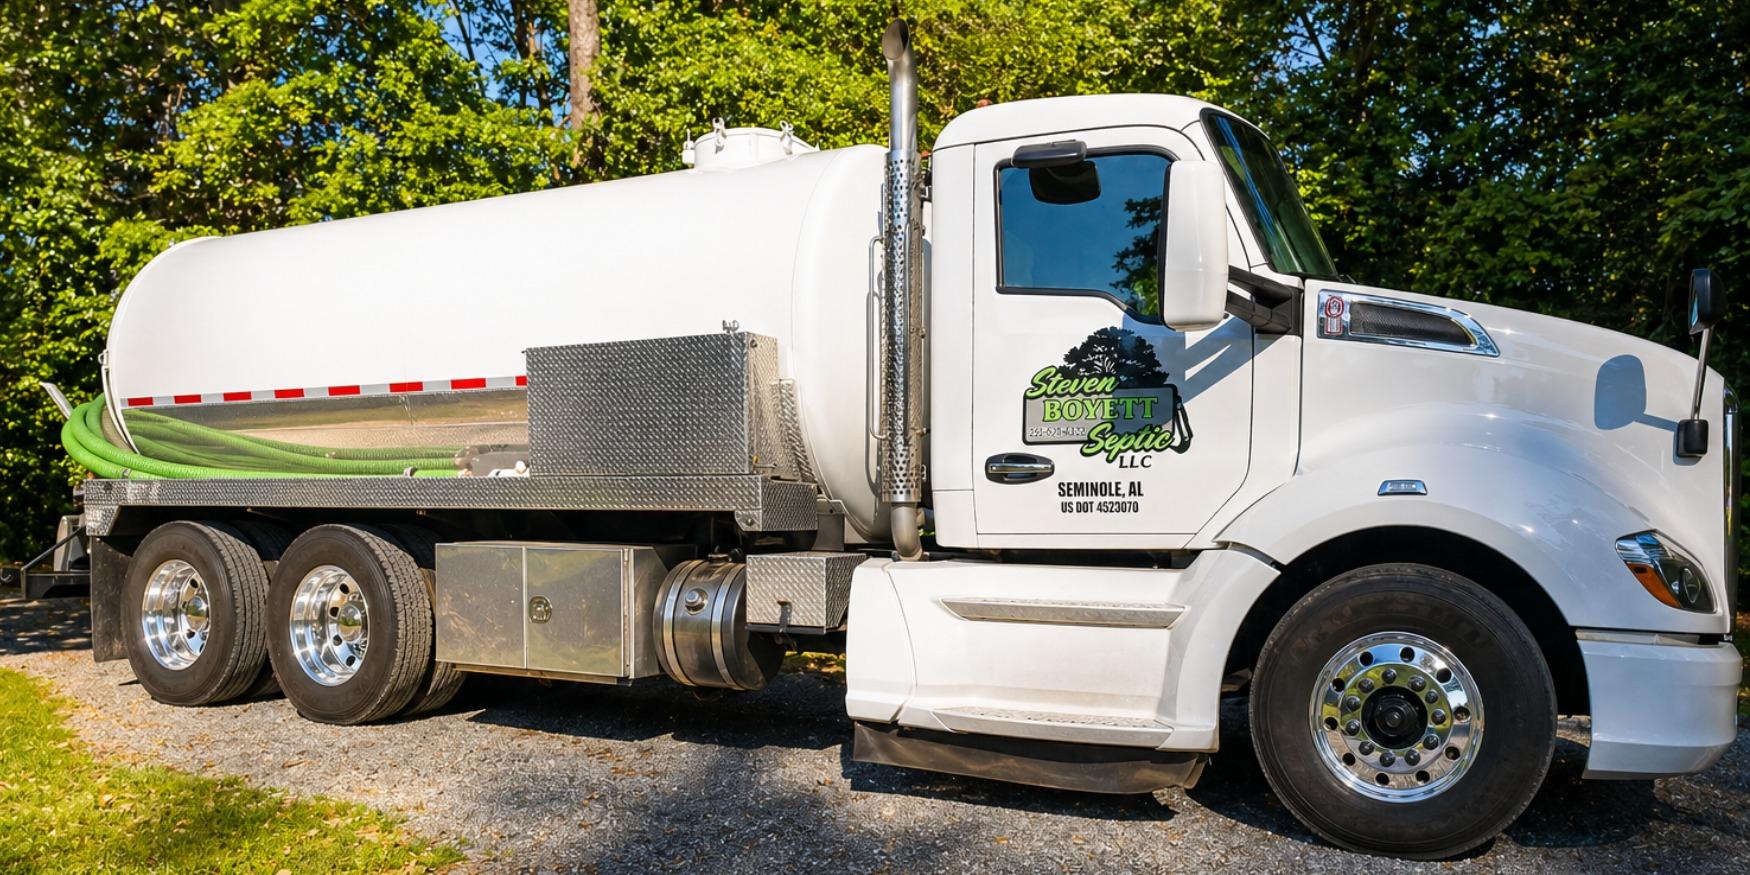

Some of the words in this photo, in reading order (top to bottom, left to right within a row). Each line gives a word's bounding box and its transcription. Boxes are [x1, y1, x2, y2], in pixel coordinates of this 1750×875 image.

[1025, 366, 1118, 398] Steven
[1043, 397, 1158, 422] BOYETT
[1082, 422, 1174, 463] Septic
[1118, 455, 1152, 468] LLC
[1058, 481, 1126, 498] SEMINOLE,
[1128, 481, 1144, 497] AL
[1061, 501, 1074, 513] US
[1076, 501, 1094, 513] DOT
[1096, 501, 1139, 513] 4523070
